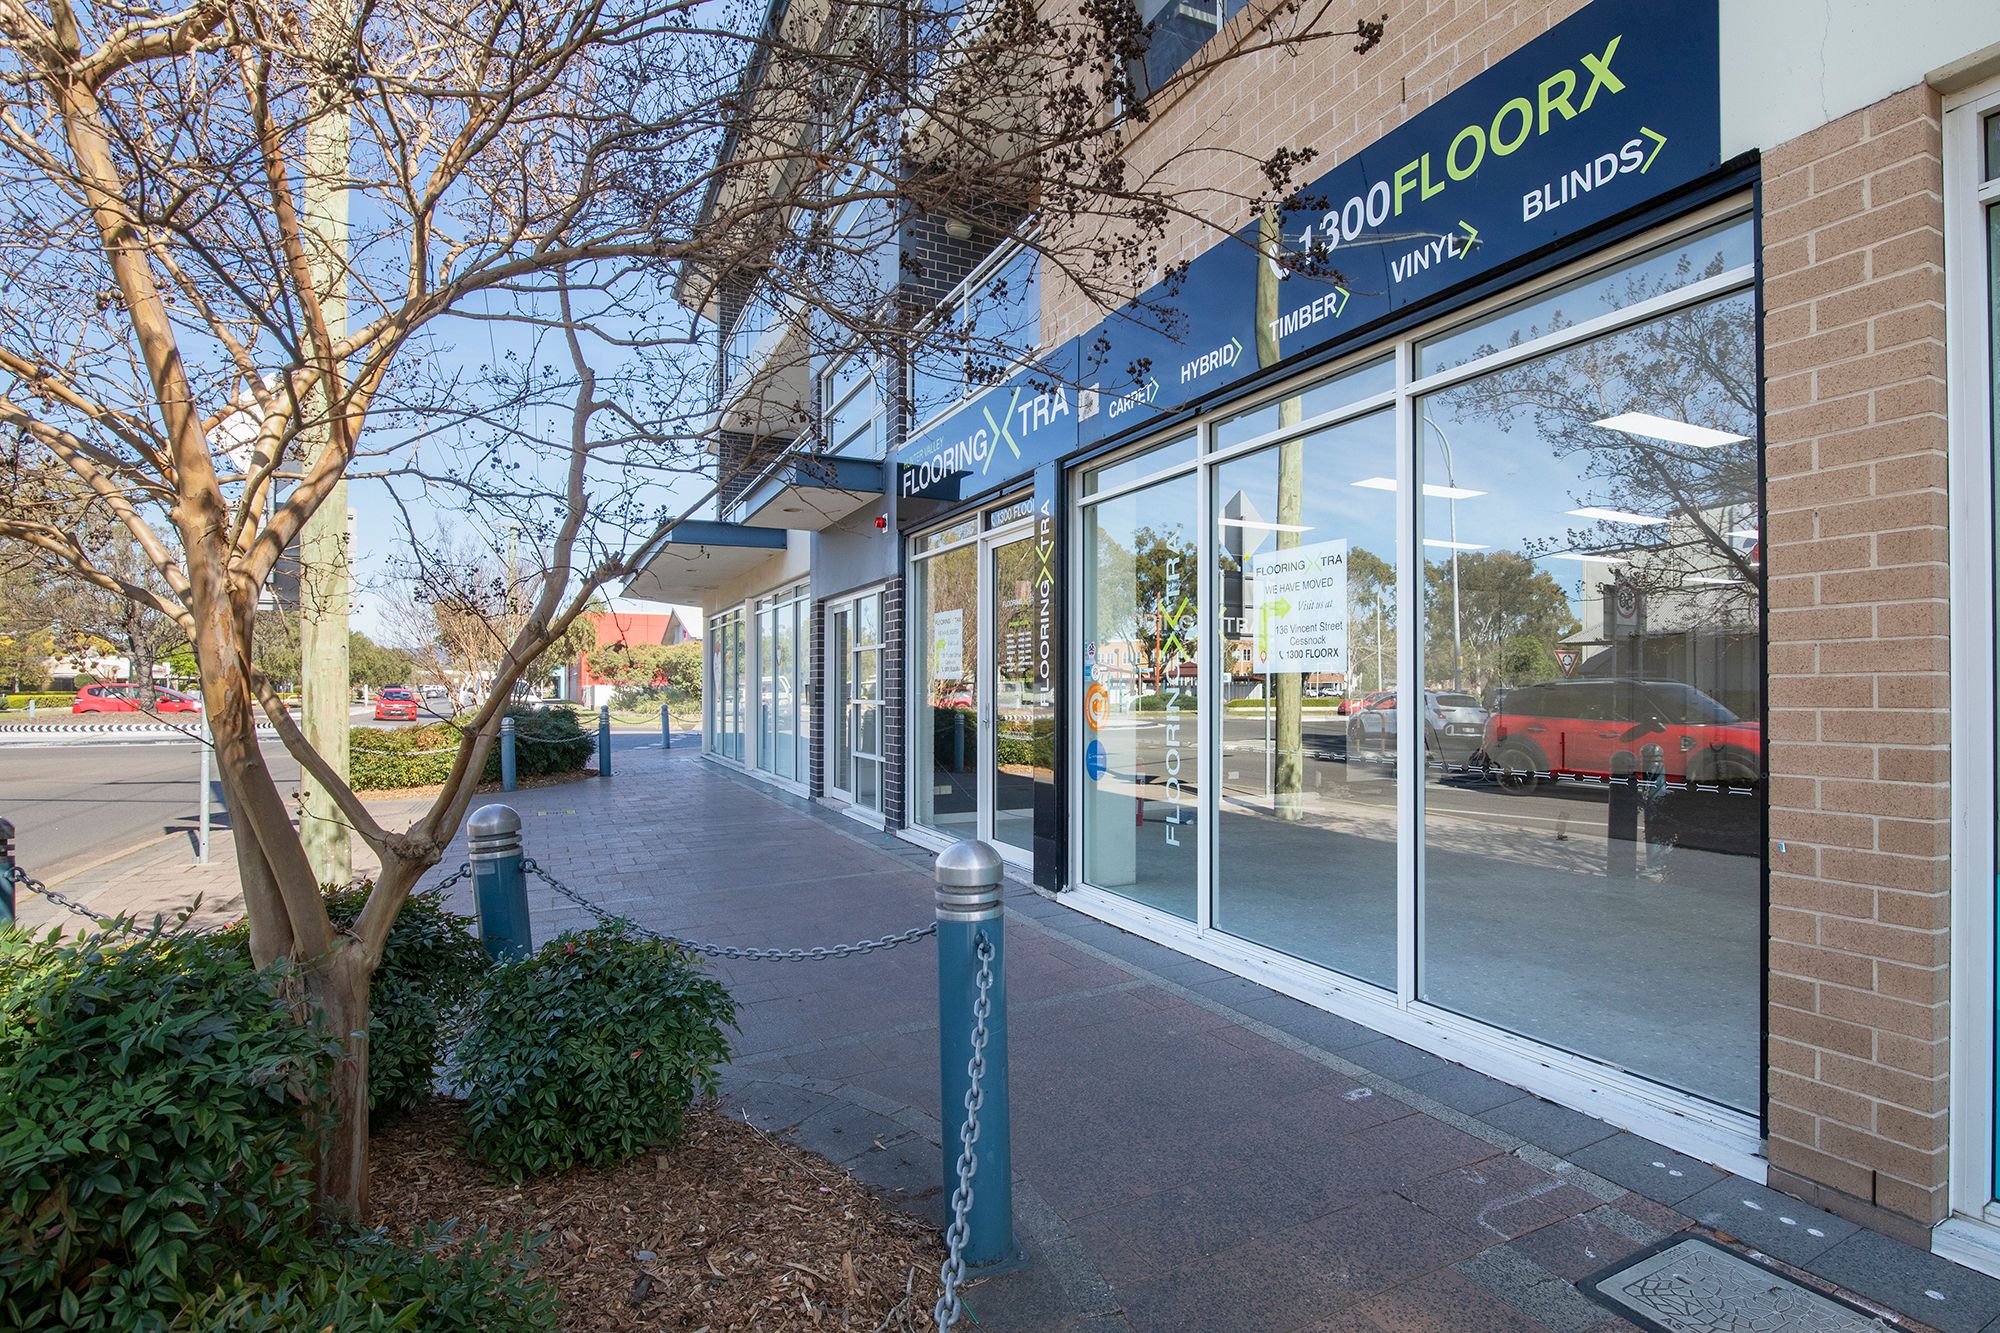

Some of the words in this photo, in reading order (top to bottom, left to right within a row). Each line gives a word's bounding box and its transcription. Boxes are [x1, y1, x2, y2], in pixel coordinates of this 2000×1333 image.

[1522, 138, 1646, 223] BLINDS
[1391, 232, 1461, 283] VINYL
[1269, 292, 1337, 342] TIMBER
[1181, 343, 1234, 384] HYBRID
[1109, 384, 1152, 418] CARPET
[1265, 584, 1278, 595] WE
[1279, 581, 1300, 593] HAVE
[1302, 577, 1334, 590] MOVED
[1289, 622, 1318, 634] Vincent
[1319, 620, 1343, 632] Street
[1289, 635, 1327, 646] Cessnock
[1286, 649, 1303, 659] 1300
[1305, 648, 1339, 659] FLOORX
